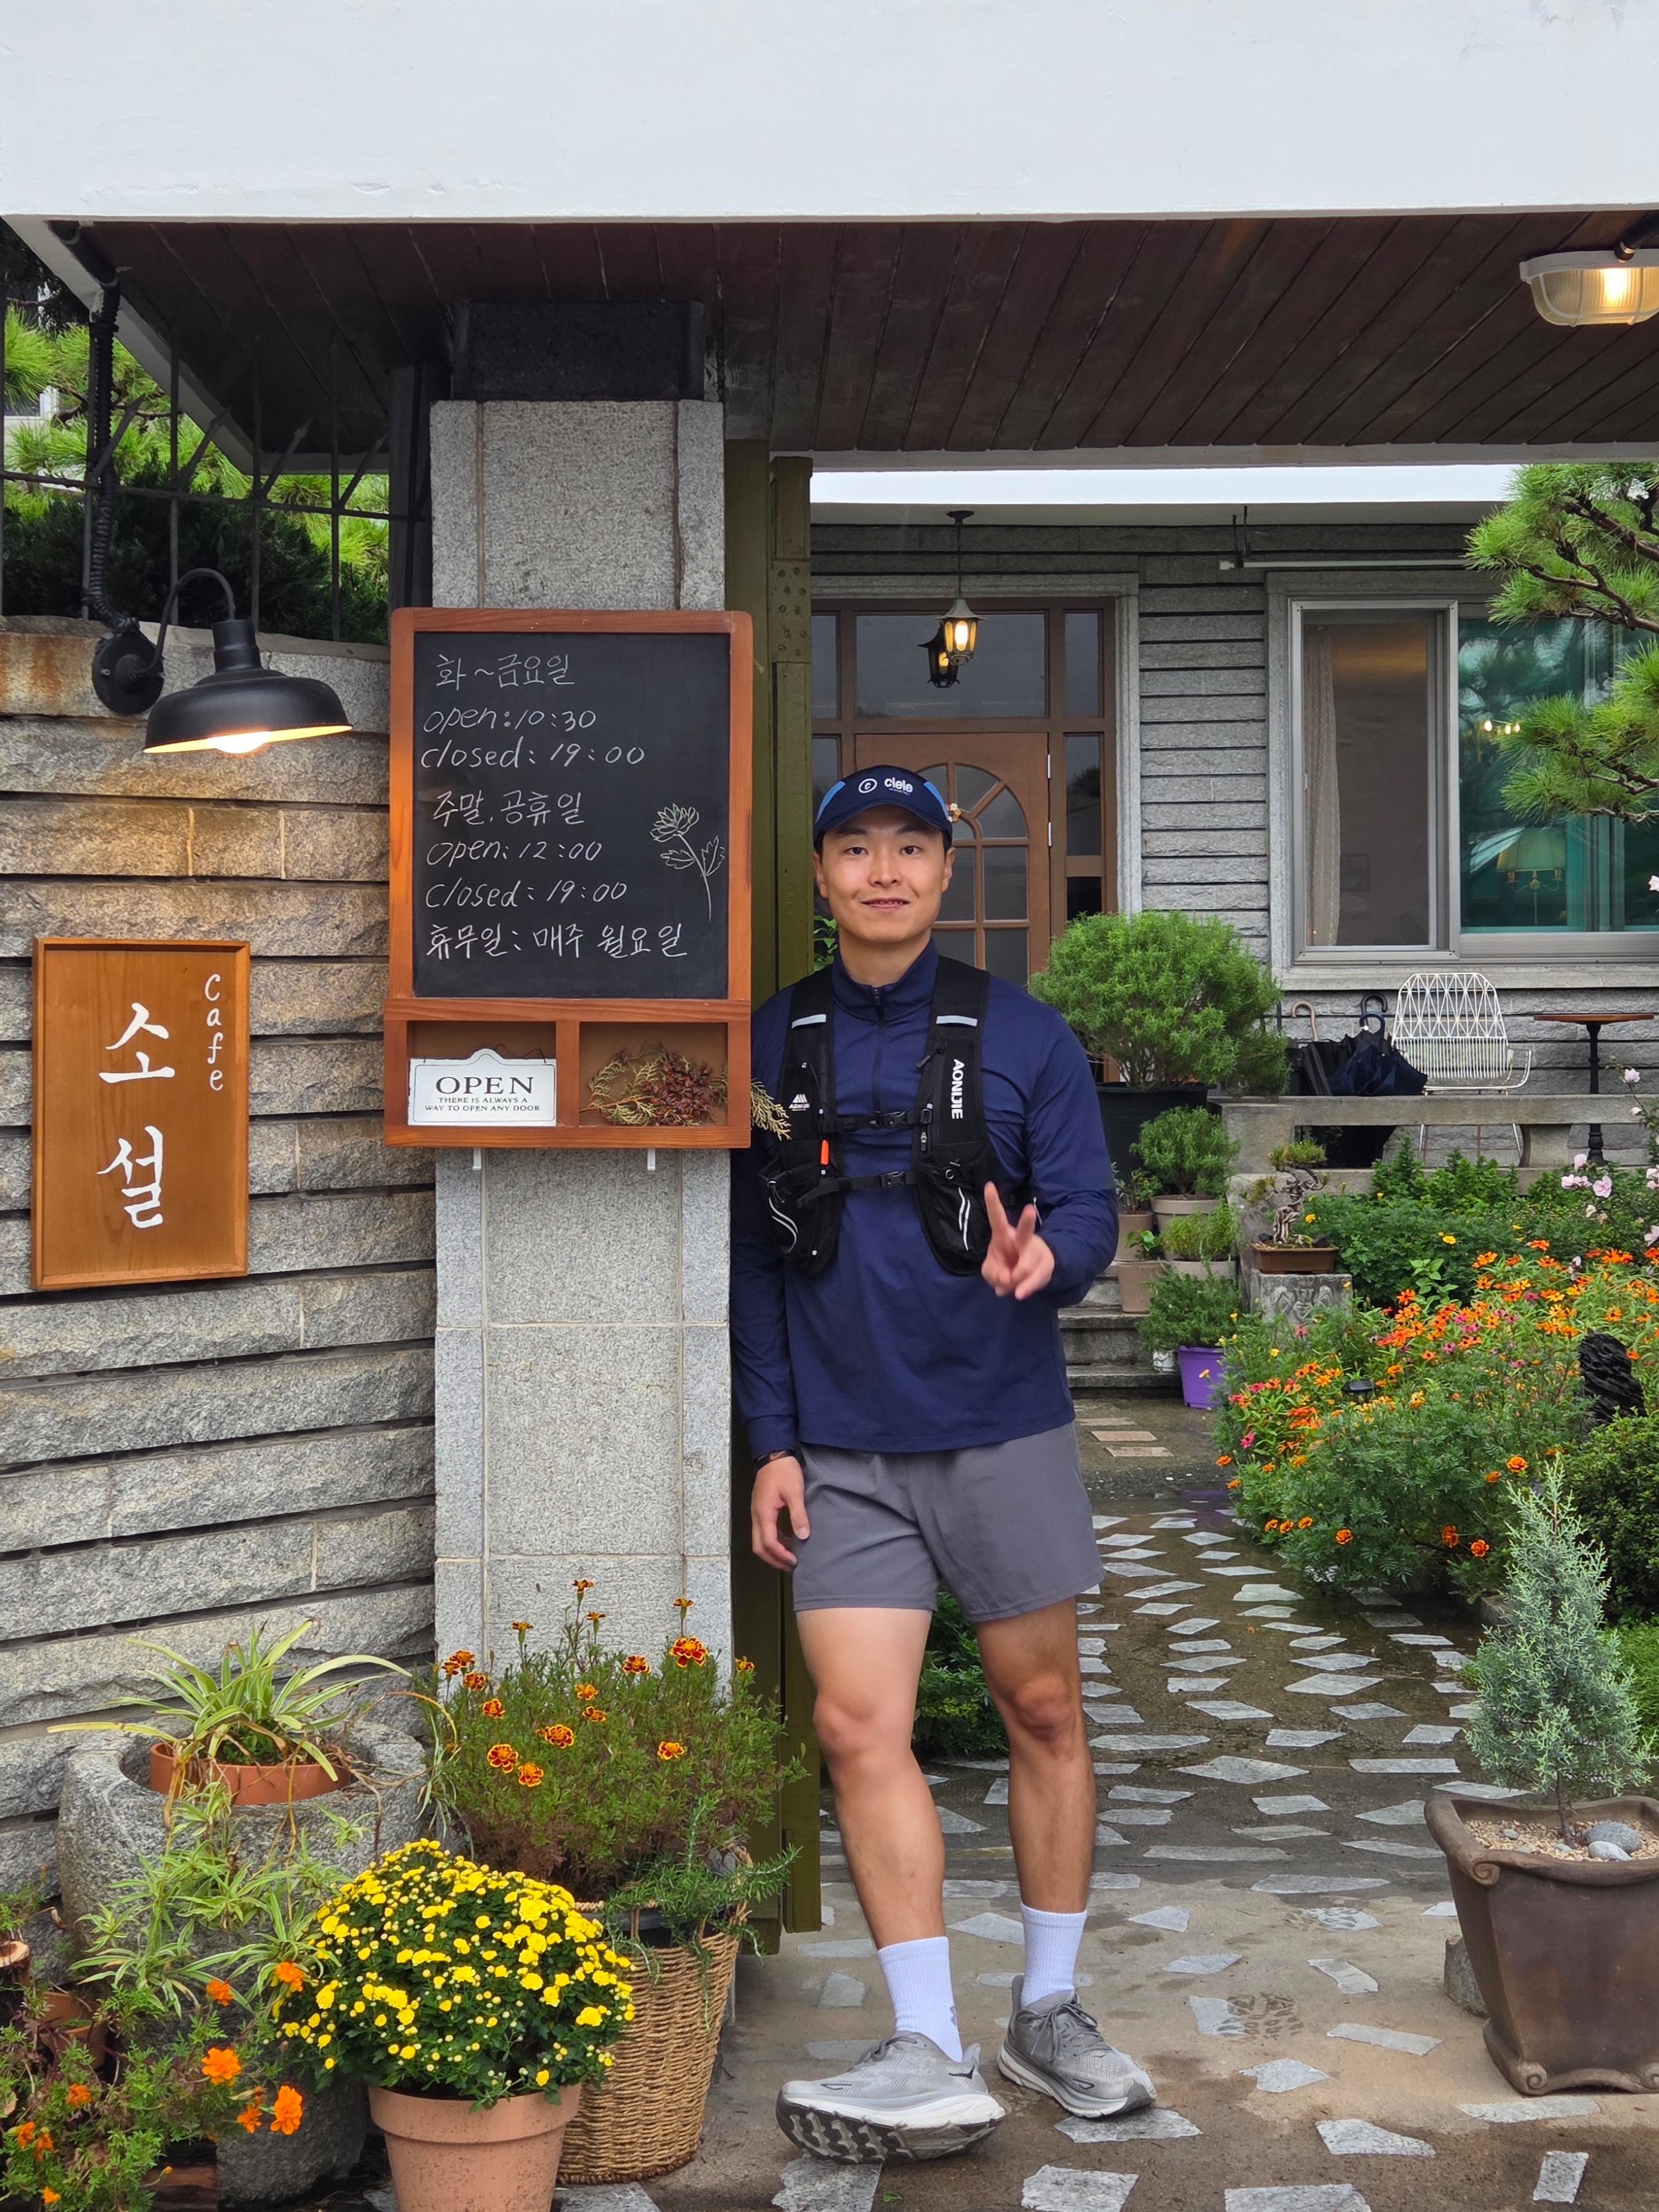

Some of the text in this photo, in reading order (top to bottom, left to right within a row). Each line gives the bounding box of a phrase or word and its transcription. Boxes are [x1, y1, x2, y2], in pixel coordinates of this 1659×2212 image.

[500, 789, 585, 827] 공휴일
[532, 923, 583, 958] 매주
[597, 923, 688, 959] 월요일
[205, 973, 224, 1091] Cafe
[436, 1076, 534, 1094] OPEN
[950, 1059, 965, 1120] AONIJIE
[96, 1002, 176, 1229] 소설
